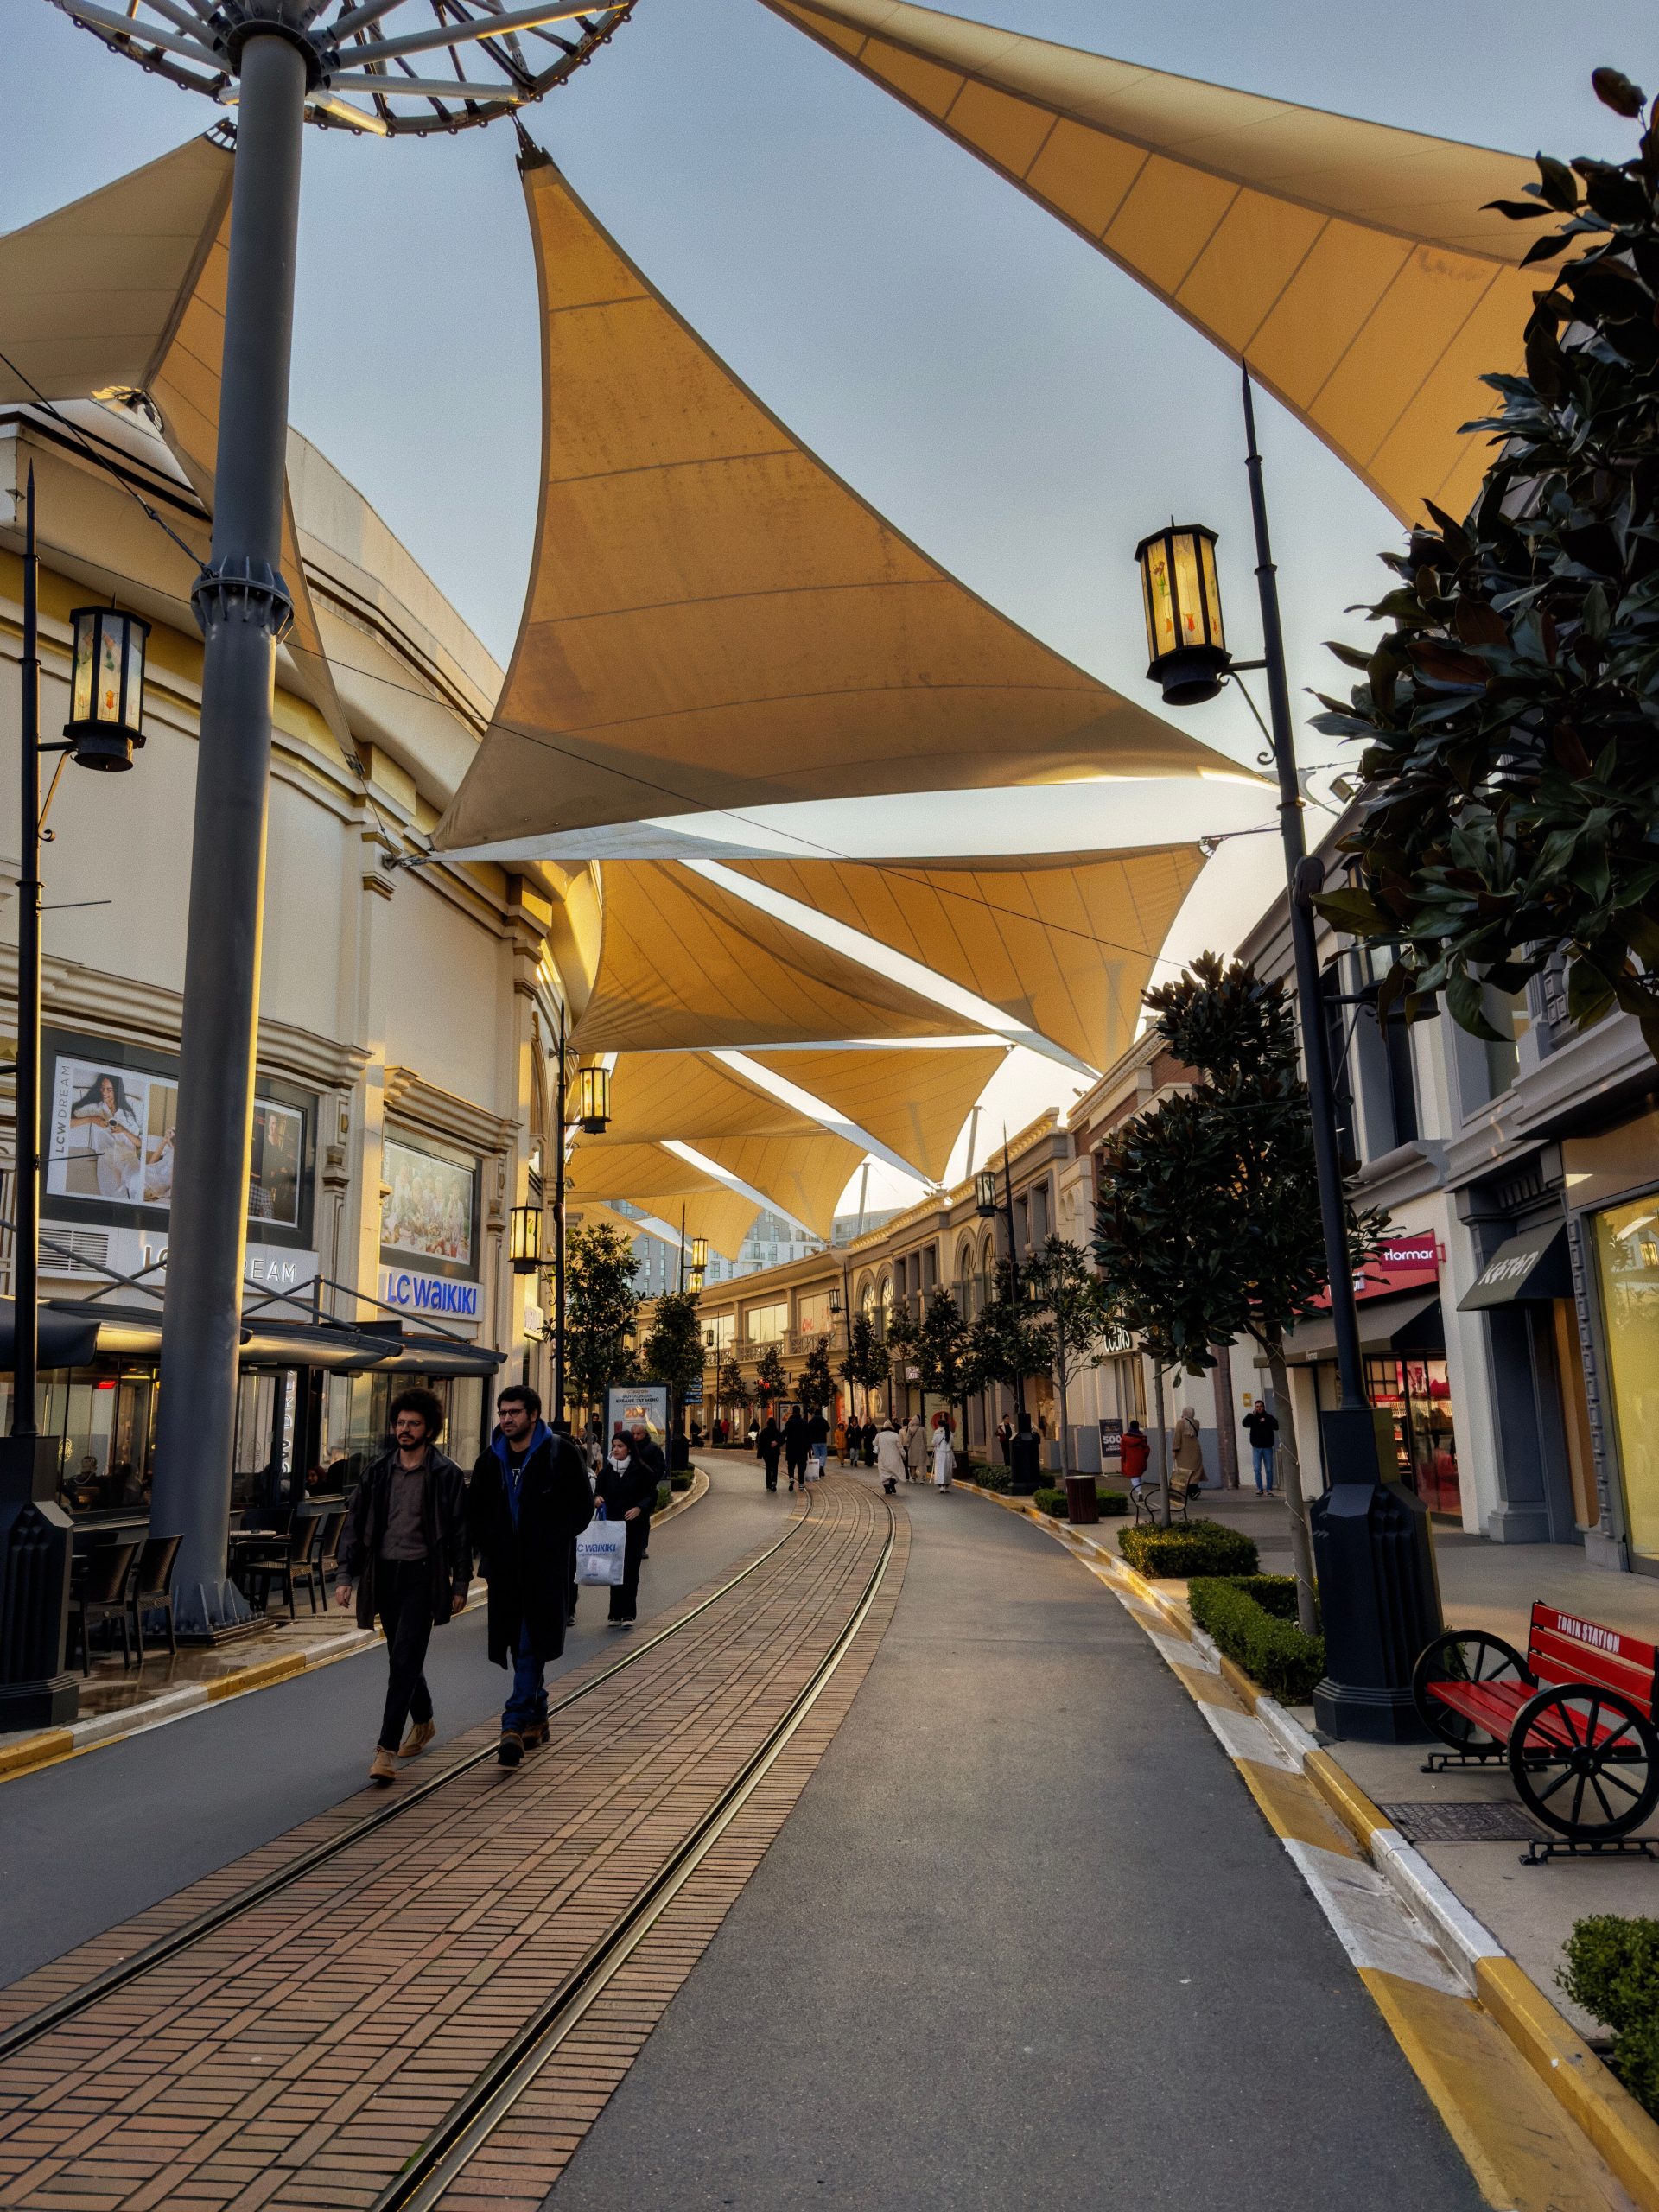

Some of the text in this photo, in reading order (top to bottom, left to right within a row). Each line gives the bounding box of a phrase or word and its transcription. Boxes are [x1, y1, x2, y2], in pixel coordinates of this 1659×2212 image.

[56, 1065, 70, 1153] LCW DREAM
[386, 1273, 410, 1304] LC
[1557, 1614, 1620, 1654] TRAIN STATION
